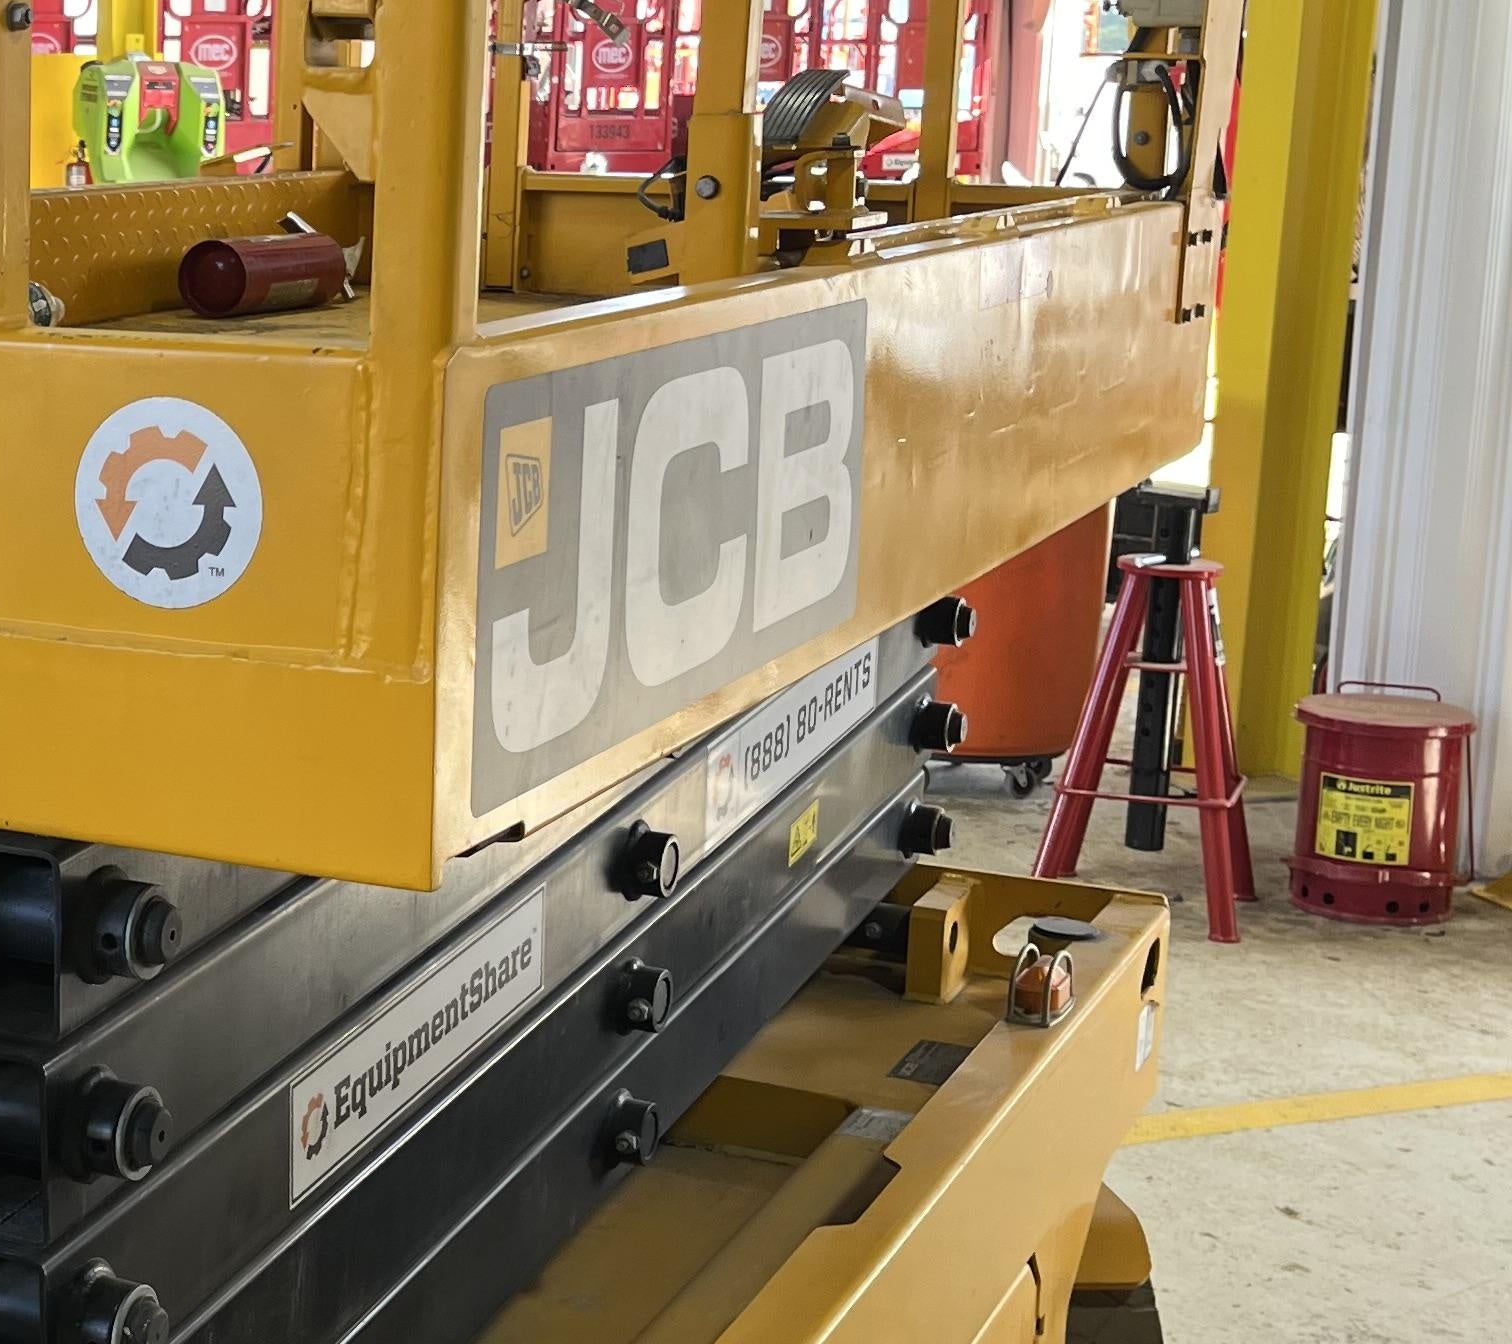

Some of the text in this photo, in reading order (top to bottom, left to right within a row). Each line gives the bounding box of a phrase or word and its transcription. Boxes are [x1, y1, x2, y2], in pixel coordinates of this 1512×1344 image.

[511, 461, 542, 527] JCB
[209, 567, 225, 578] TM
[491, 338, 854, 754] JCB
[744, 652, 872, 792] (888) 80-RENTS
[1348, 781, 1392, 796] Justrite
[334, 937, 533, 1130] EquipmentShare
